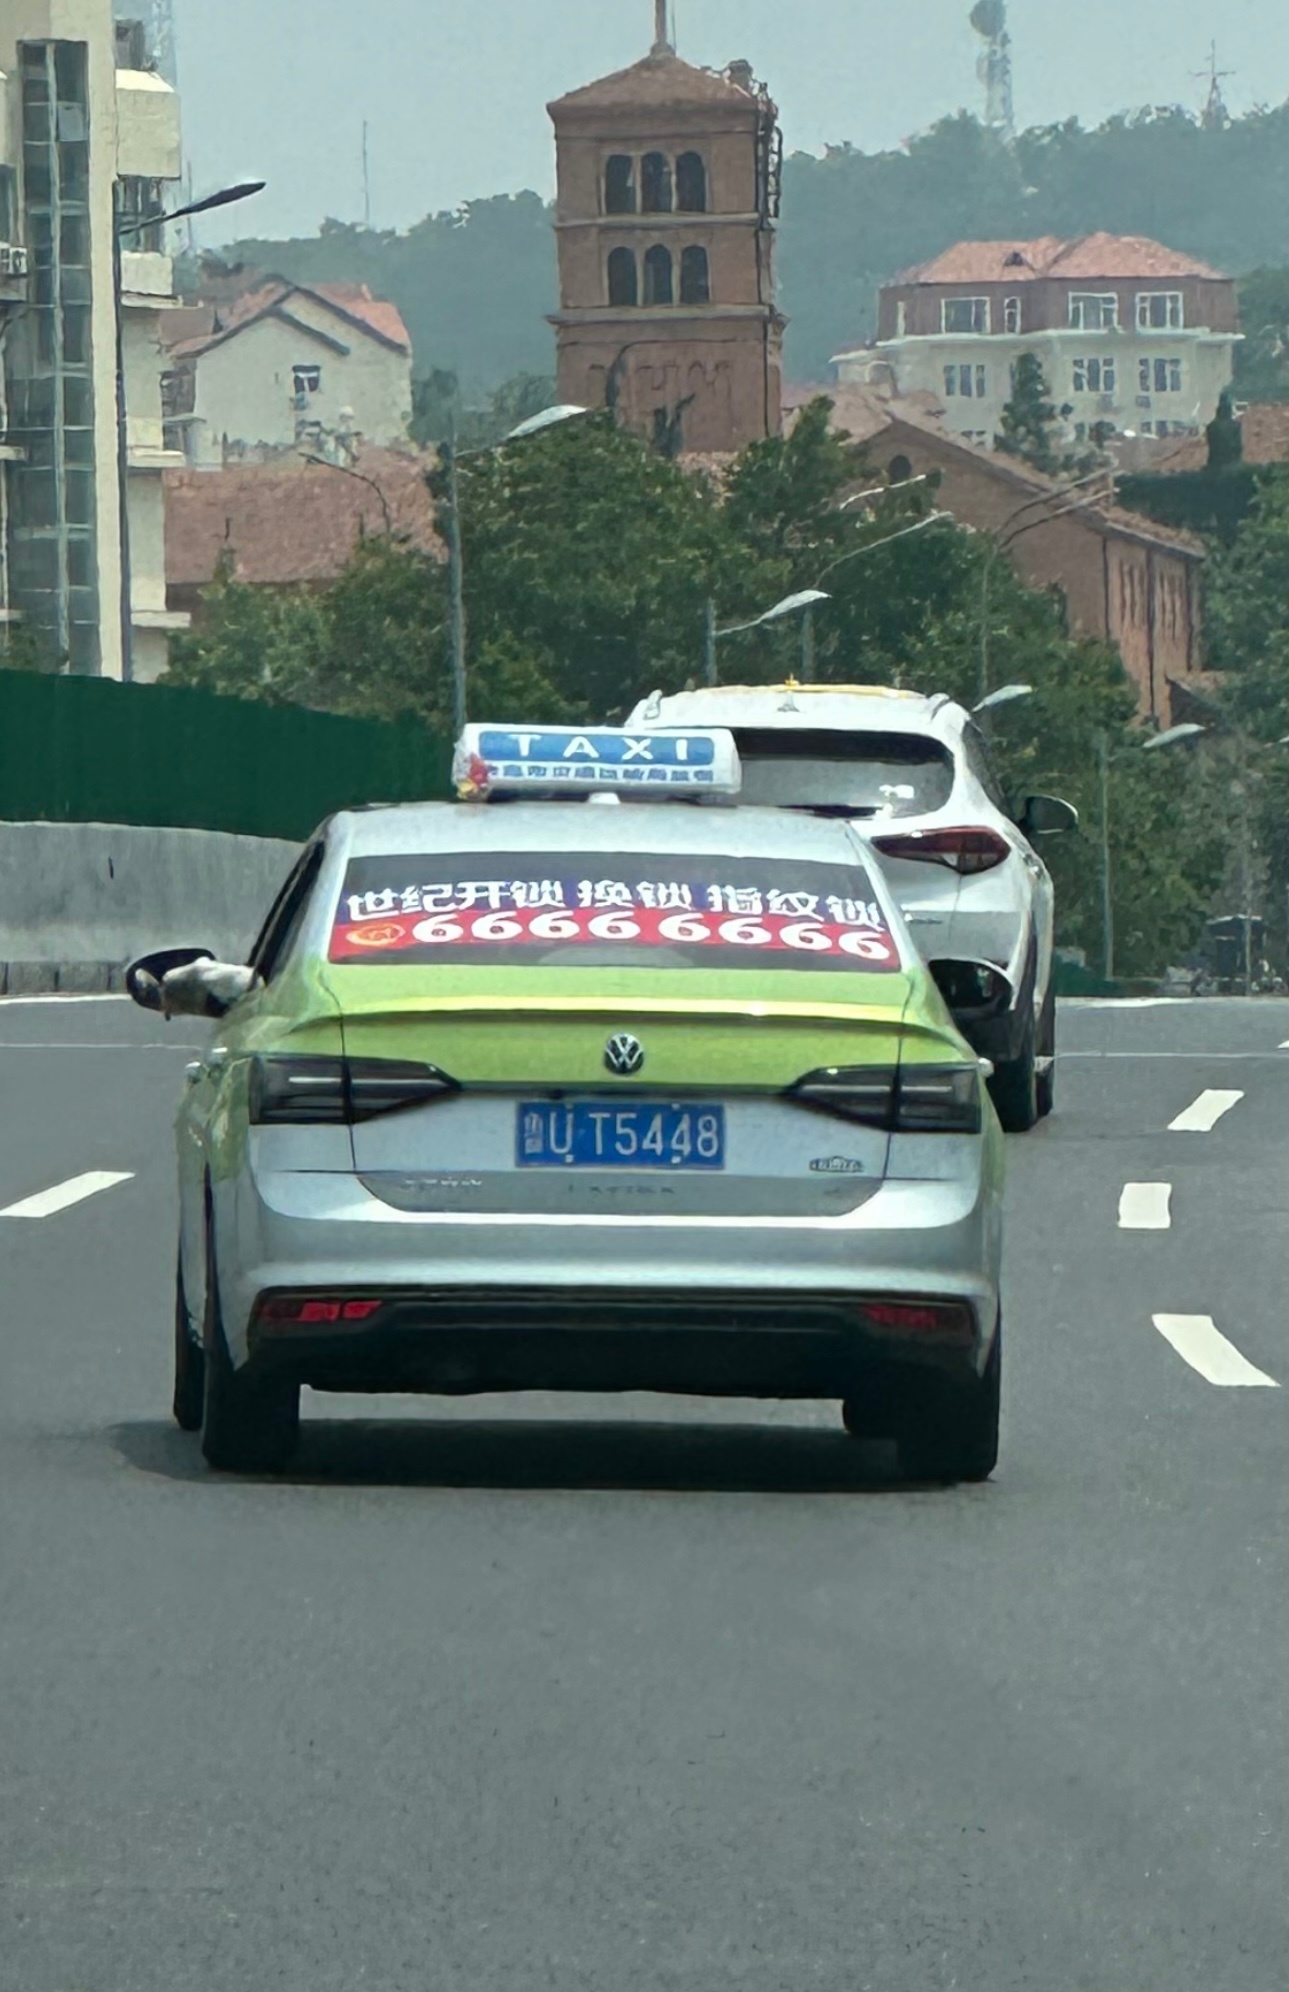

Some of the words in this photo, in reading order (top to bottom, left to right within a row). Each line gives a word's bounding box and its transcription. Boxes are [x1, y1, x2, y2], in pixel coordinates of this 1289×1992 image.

[509, 734, 688, 761] TAXI
[346, 879, 565, 921] 世纪开锁
[411, 910, 641, 943] 6666
[658, 912, 890, 960] 6666
[588, 1112, 719, 1158] T5448
